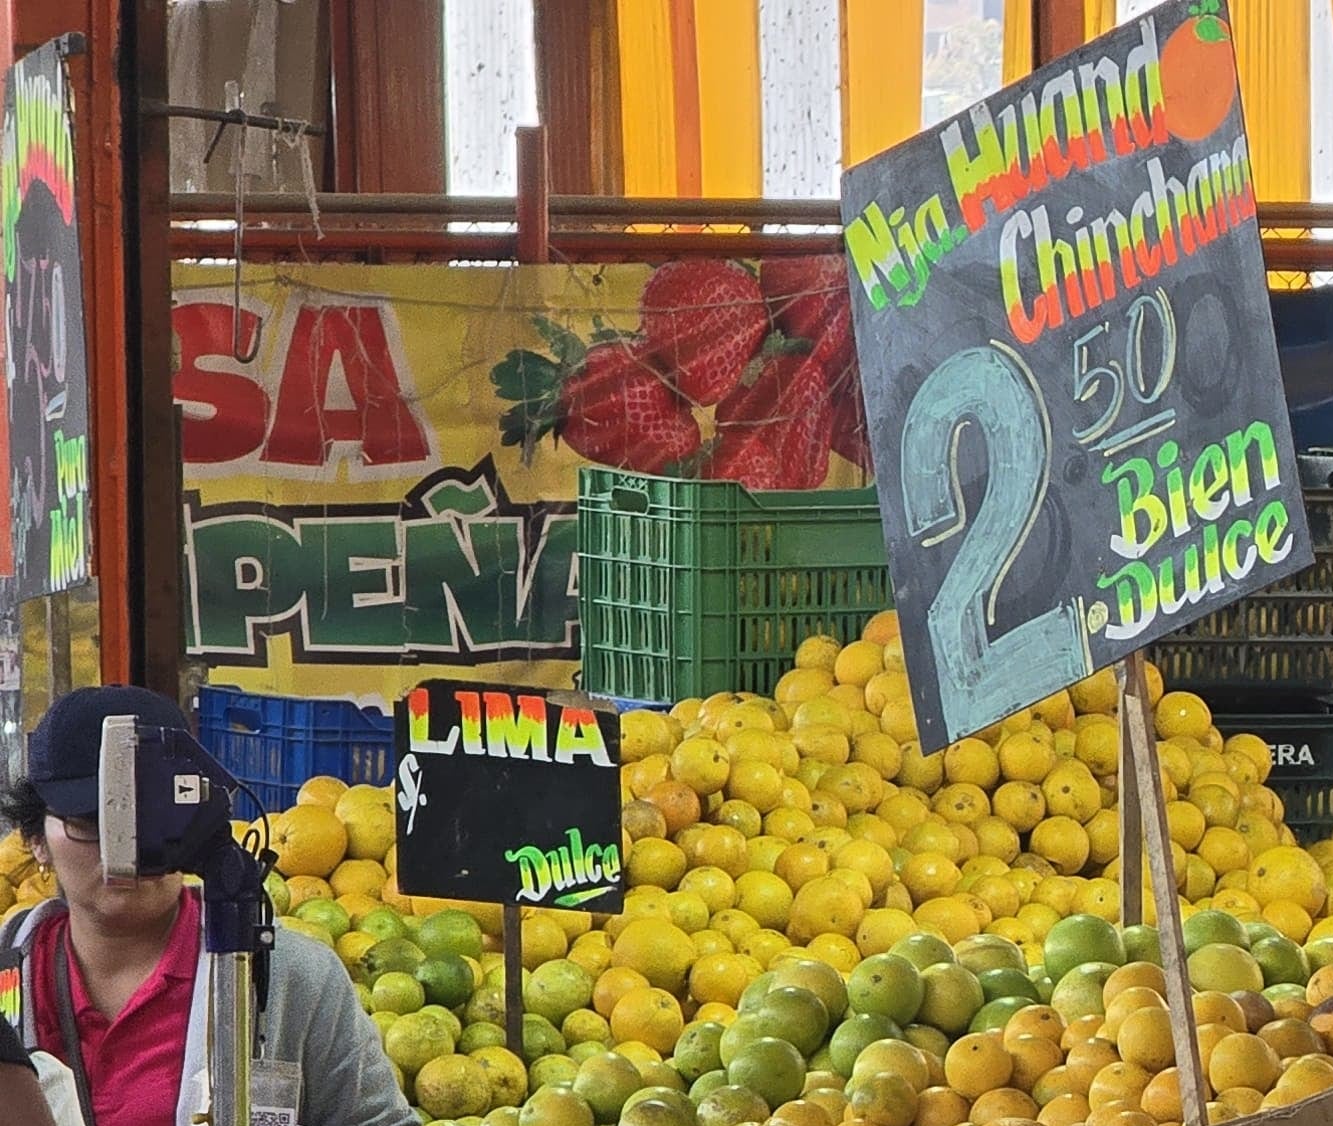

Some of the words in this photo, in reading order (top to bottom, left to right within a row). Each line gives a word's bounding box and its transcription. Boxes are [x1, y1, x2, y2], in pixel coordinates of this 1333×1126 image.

[900, 338, 1094, 743] 2
[1101, 419, 1283, 560] Bien
[1098, 499, 1294, 641] Dulce
[407, 687, 618, 768] LIMA
[505, 827, 622, 902] Dulce
